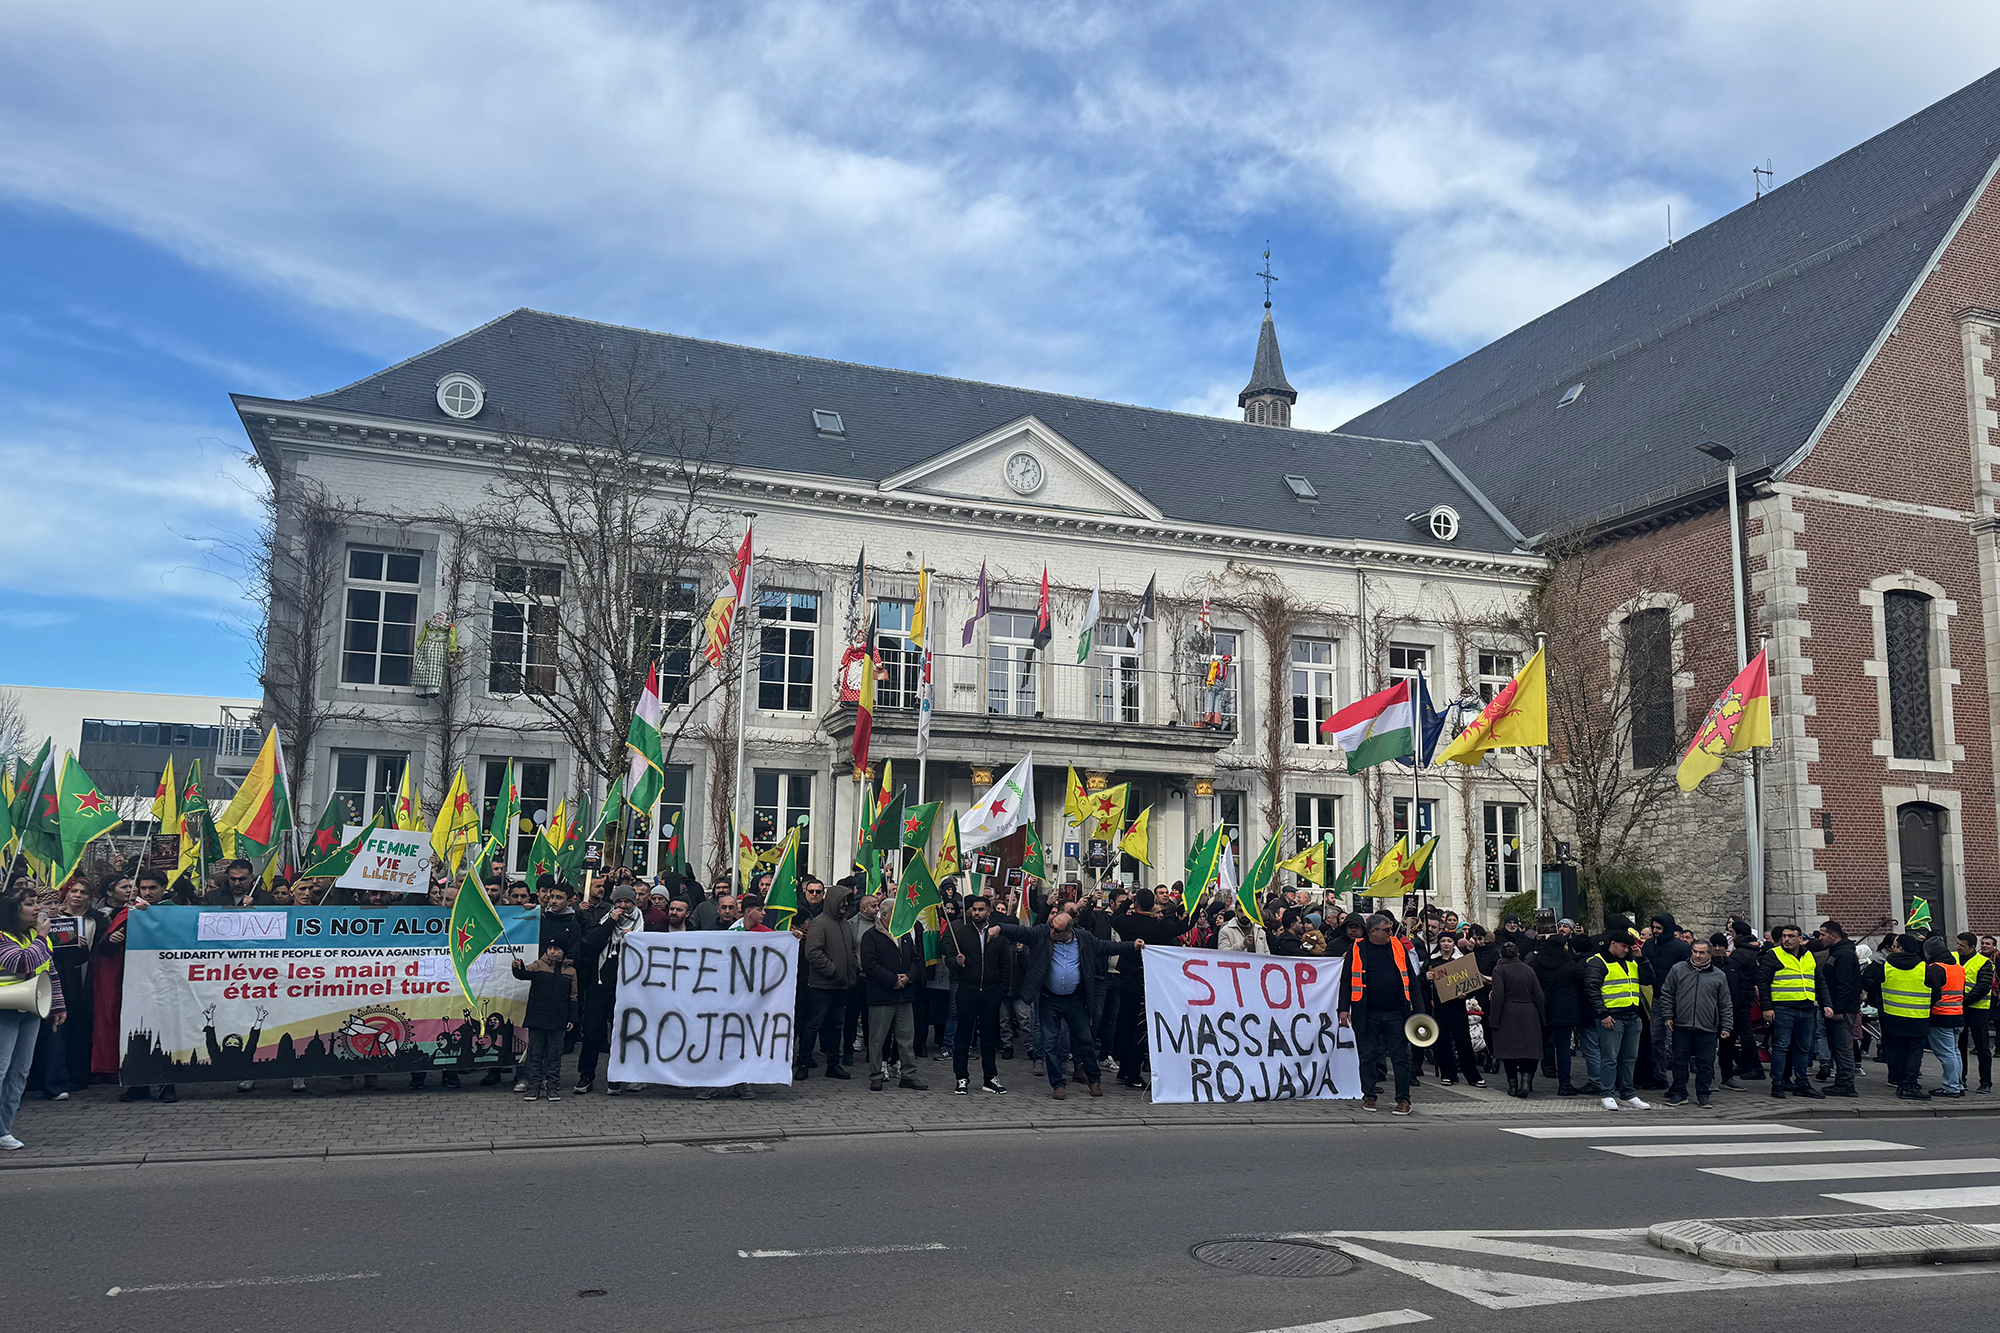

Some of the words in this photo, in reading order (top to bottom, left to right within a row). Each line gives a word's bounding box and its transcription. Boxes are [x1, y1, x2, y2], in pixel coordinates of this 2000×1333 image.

[366, 839, 419, 857] FEMME
[377, 856, 401, 870] VIE
[203, 916, 282, 936] ROJAVA
[296, 919, 321, 935] IS
[331, 918, 384, 935] NOT
[392, 918, 451, 935] ALO
[159, 951, 225, 959] SOLIDARITY
[282, 950, 321, 958] PEOPLE
[341, 949, 383, 957] ROJAVA
[386, 949, 431, 957] AGAINST
[483, 946, 524, 954] ASCISM!
[188, 963, 279, 981] Enléve
[288, 963, 326, 979] les
[335, 962, 396, 978] main
[621, 942, 788, 996] DEFEND
[223, 982, 278, 1000] état
[287, 979, 391, 997] criminel
[401, 978, 450, 995] turc
[1182, 958, 1318, 1010] STOP
[620, 1007, 791, 1065] ROJAVA
[1191, 1058, 1339, 1103] ROJAVA
